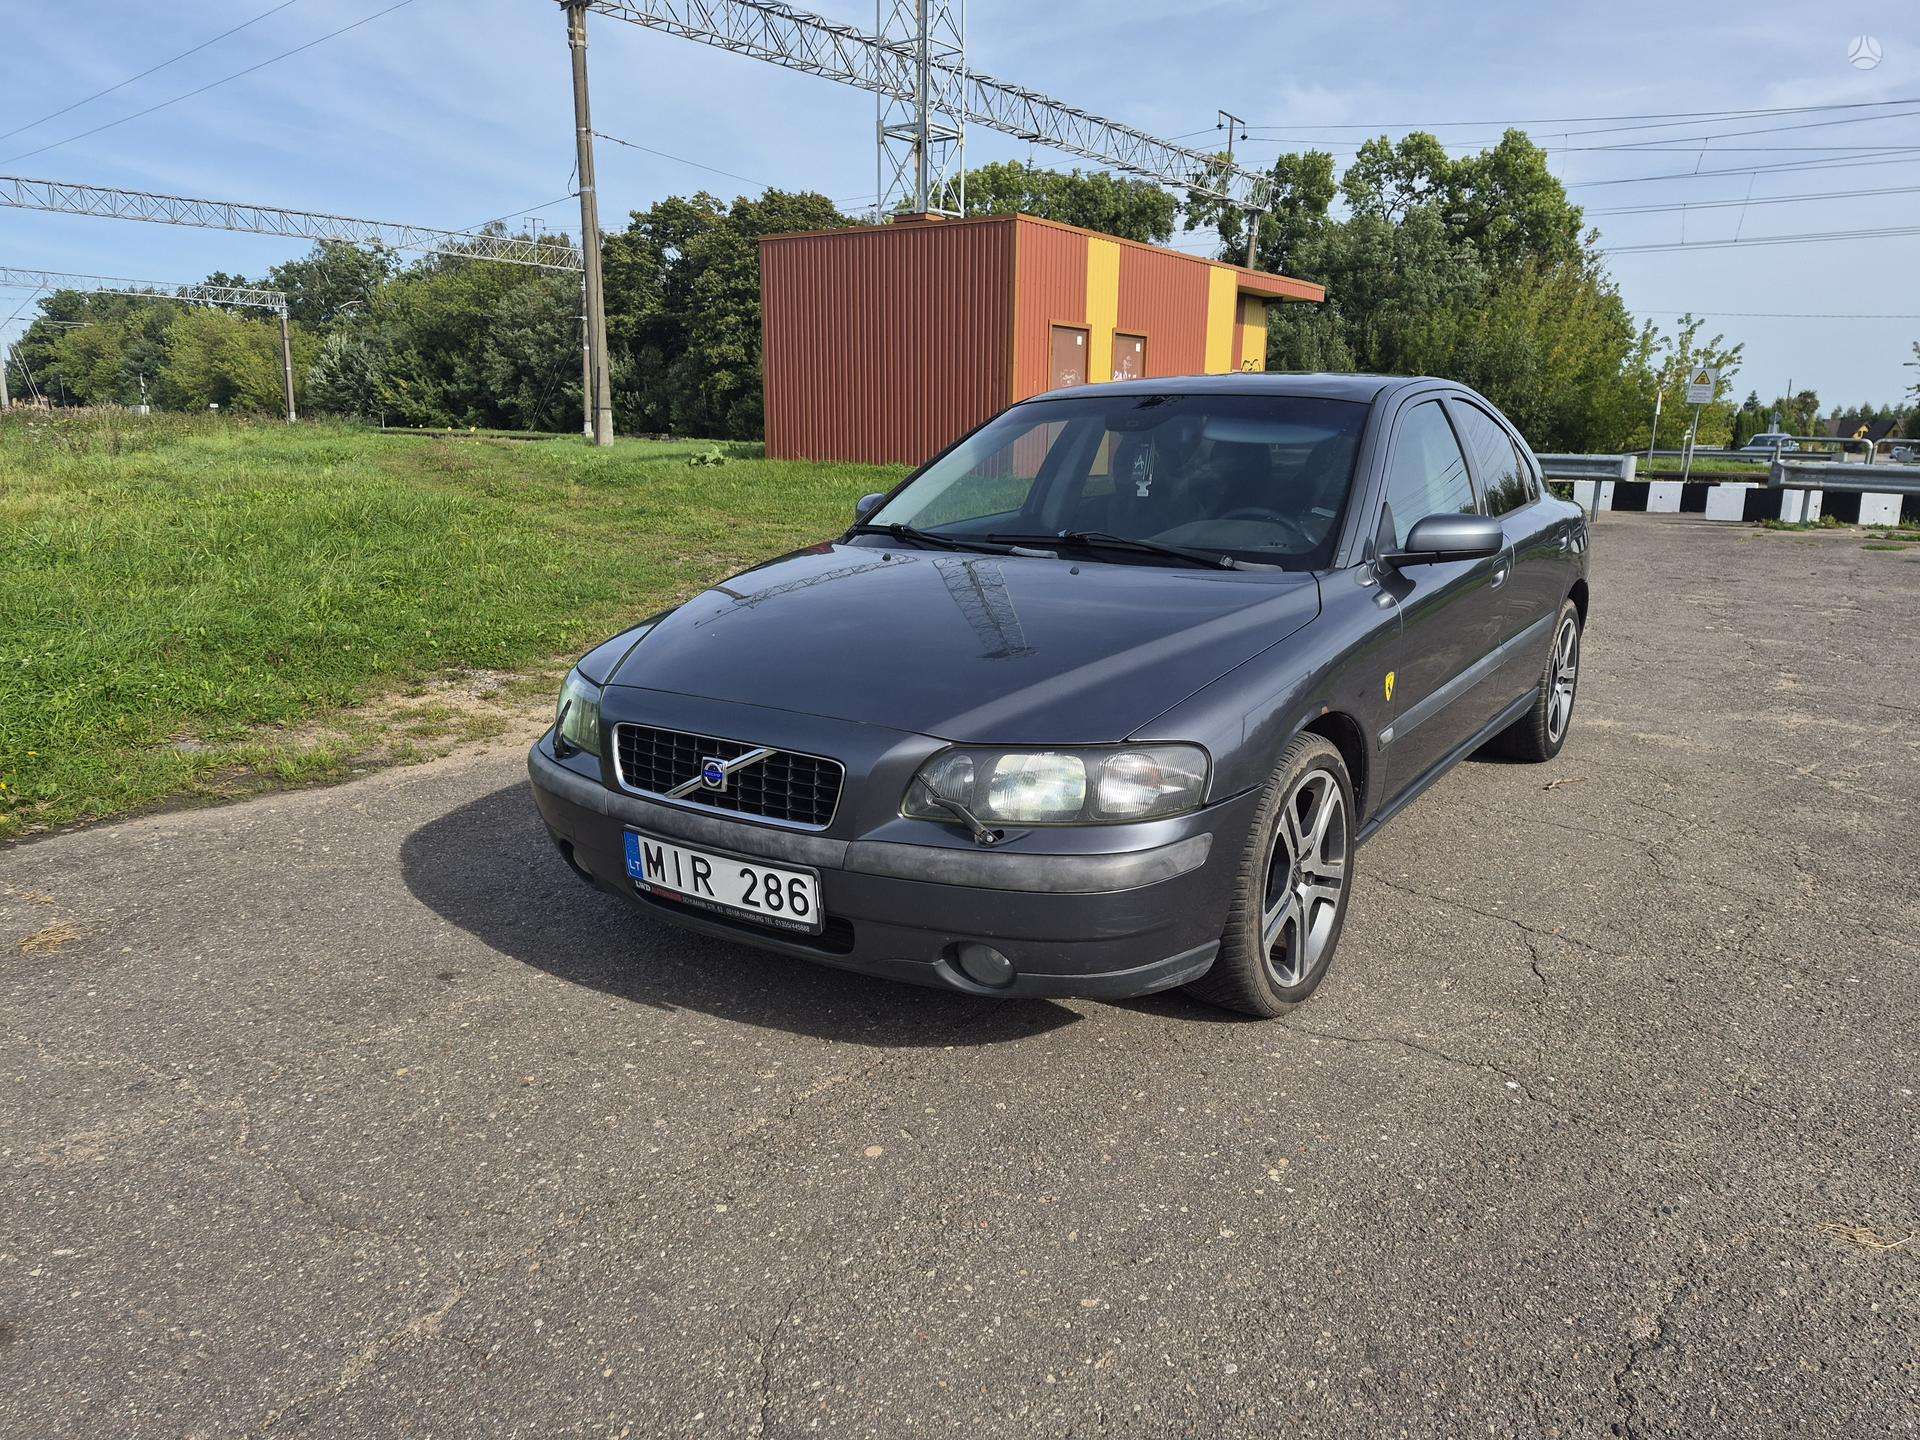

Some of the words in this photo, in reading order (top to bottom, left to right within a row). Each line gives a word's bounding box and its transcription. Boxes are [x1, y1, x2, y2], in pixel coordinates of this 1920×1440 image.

[628, 858, 641, 871] LT
[643, 841, 715, 897] MIR
[739, 867, 810, 917] 286
